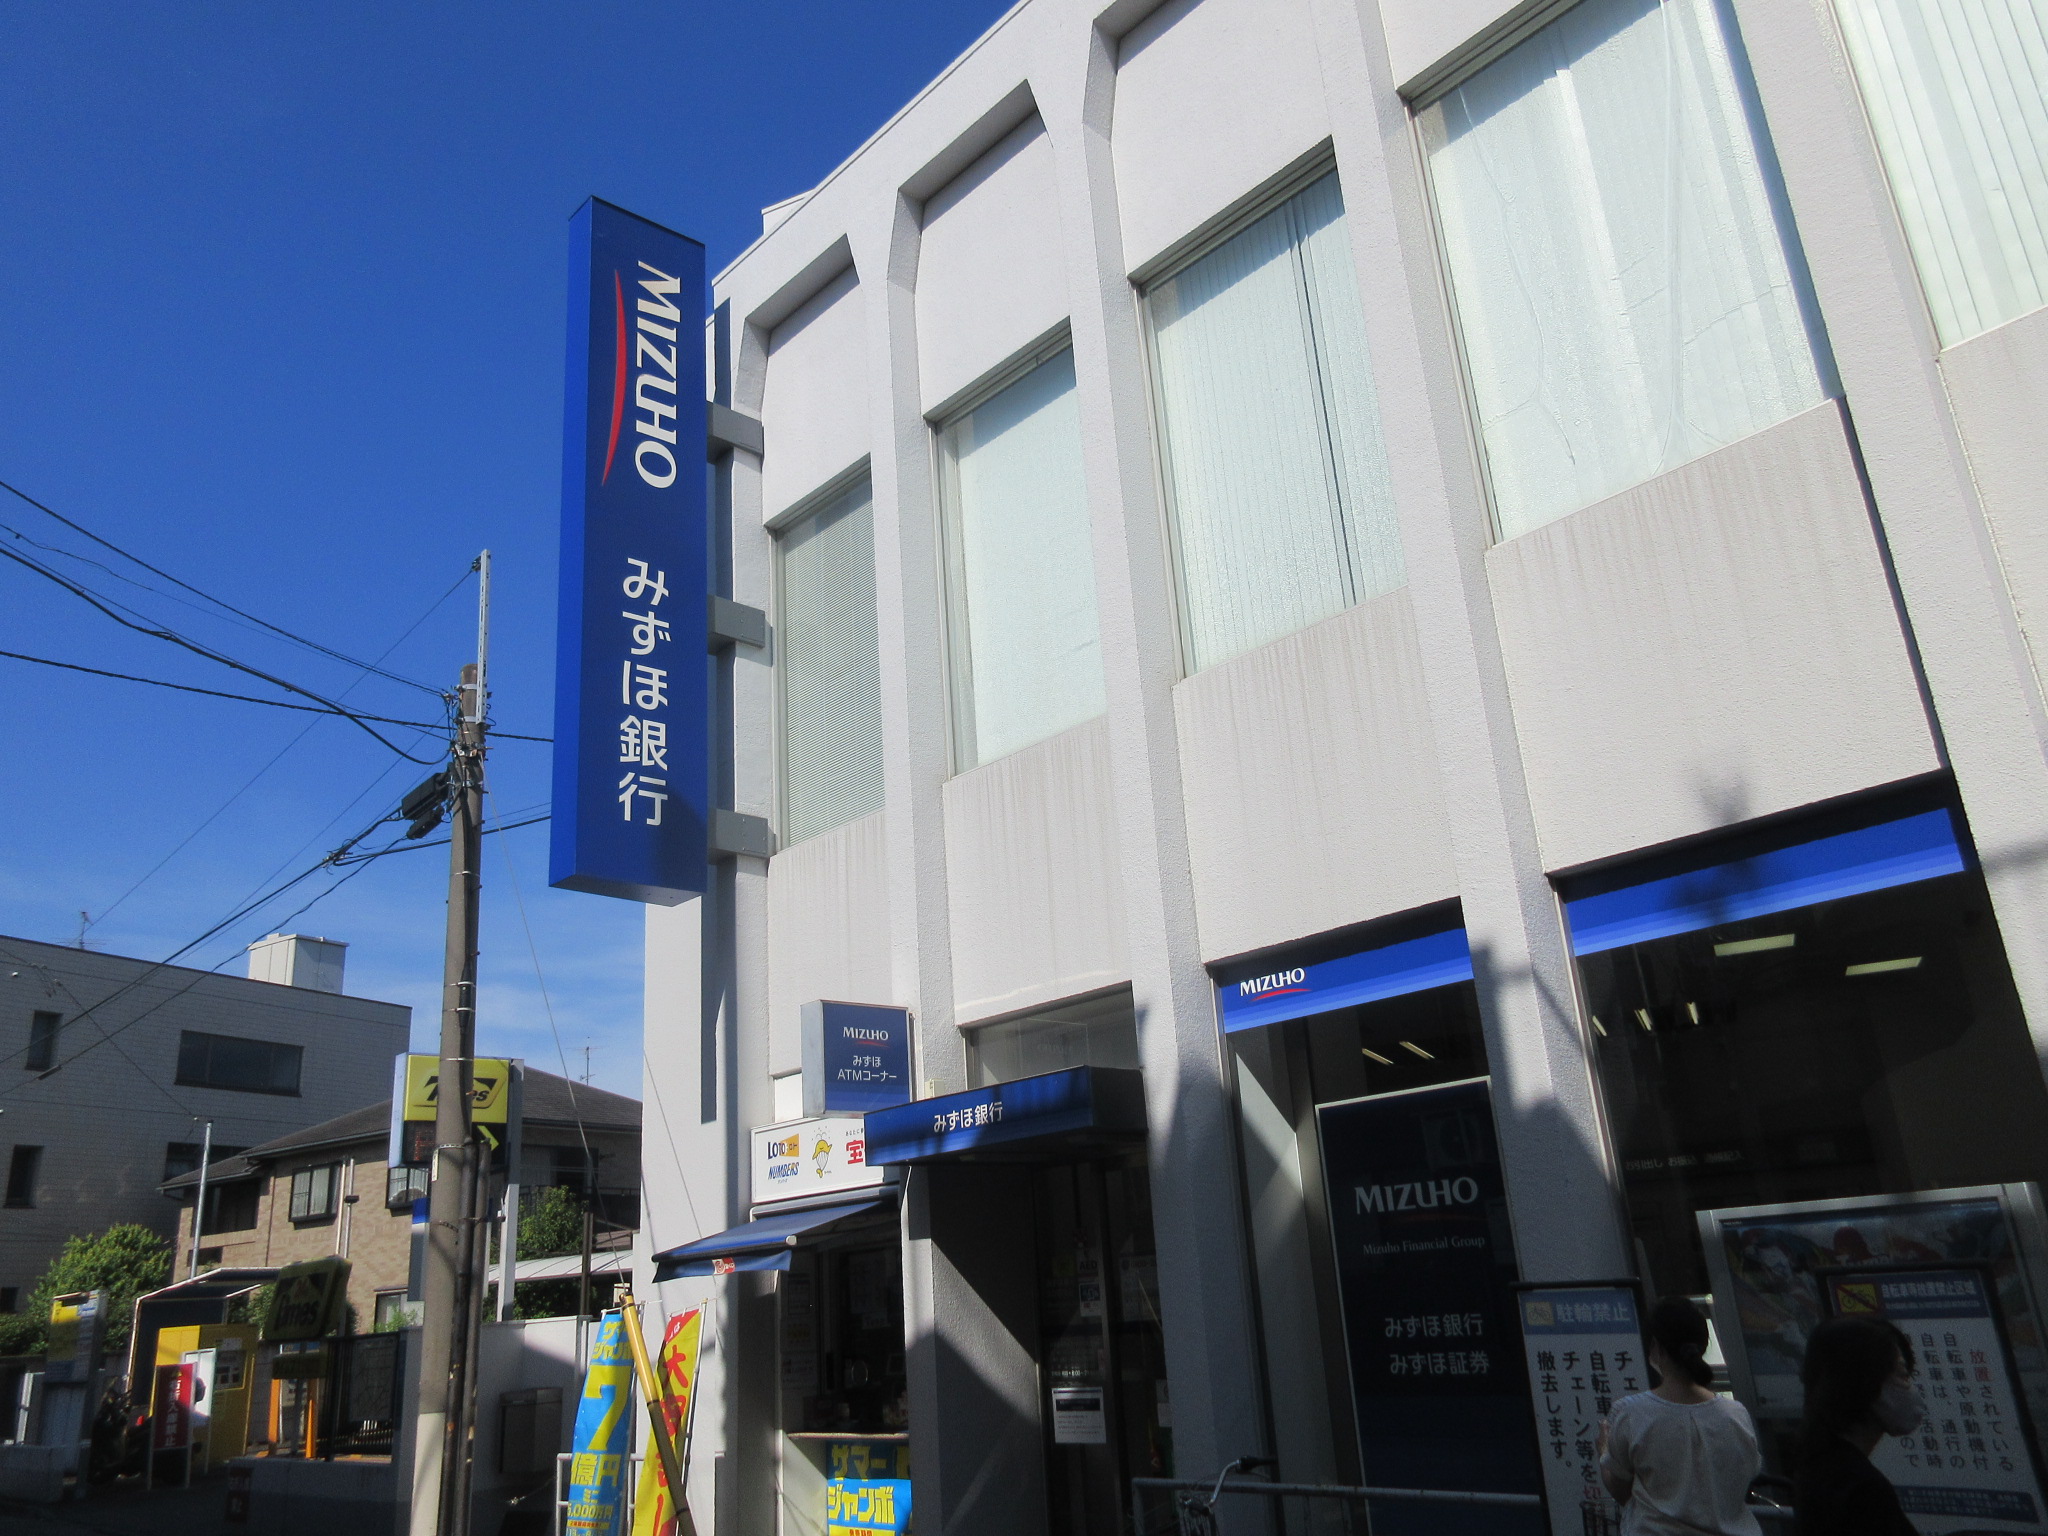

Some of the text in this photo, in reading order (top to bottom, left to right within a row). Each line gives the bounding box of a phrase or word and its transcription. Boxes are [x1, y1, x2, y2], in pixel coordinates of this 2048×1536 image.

[635, 261, 681, 488] MIZUHO
[617, 557, 671, 827] みずほ銀行
[1240, 967, 1306, 997] MIZUHO
[843, 1026, 889, 1041] MIZUHO
[837, 1068, 898, 1083] ATMコーナー
[852, 1055, 882, 1068] みずほ
[933, 1101, 1004, 1134] みずほ銀行
[845, 1139, 864, 1165] 宝
[767, 1161, 800, 1181] NUMBERS
[1354, 1176, 1480, 1215] MIZUHO
[1362, 1234, 1487, 1256] Mizuho Financial Group
[1384, 1312, 1484, 1339] みずほ銀行
[1555, 1301, 1631, 1323] 駐輪禁止
[1389, 1349, 1491, 1376] みずほ証券
[584, 1364, 632, 1451] 7
[1536, 1350, 1573, 1469] 撤去します。
[1970, 1349, 2014, 1472] 放置されている
[570, 1452, 622, 1487] 億円
[831, 1444, 888, 1482] サマー
[827, 1483, 896, 1525] ジャンボ
